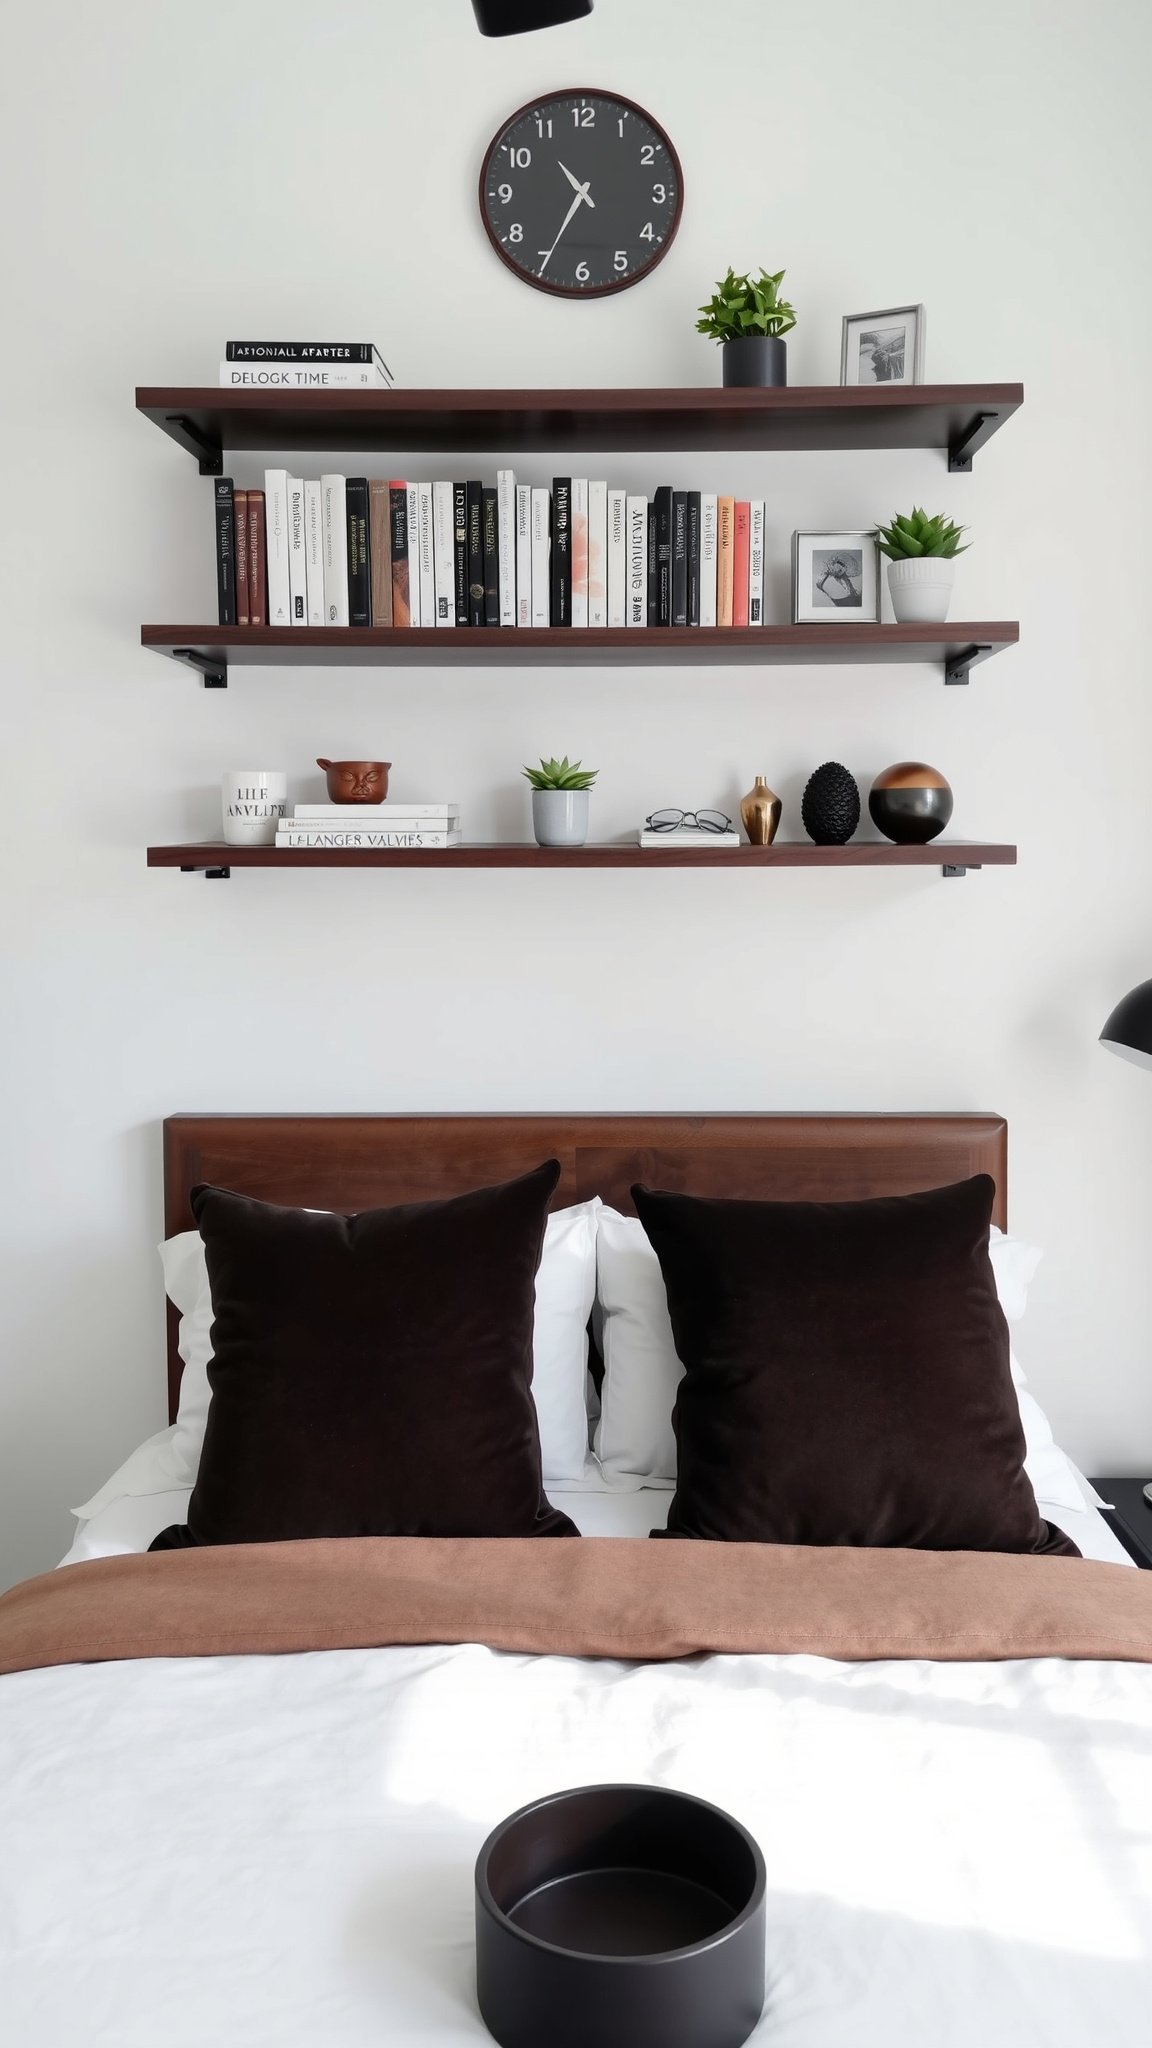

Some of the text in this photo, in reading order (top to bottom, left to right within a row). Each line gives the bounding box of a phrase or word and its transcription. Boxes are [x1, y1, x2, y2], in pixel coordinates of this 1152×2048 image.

[571, 107, 596, 127] 12
[535, 119, 553, 138] 11
[617, 119, 623, 138] 1
[509, 147, 532, 168] 10
[640, 145, 655, 165] 2
[497, 183, 513, 204] 9
[652, 183, 666, 204] 3
[509, 223, 524, 243] 8
[639, 222, 655, 242] 4
[537, 250, 553, 272] 7
[613, 250, 628, 271] 5
[575, 261, 590, 281] 6
[294, 372, 329, 385] TIME
